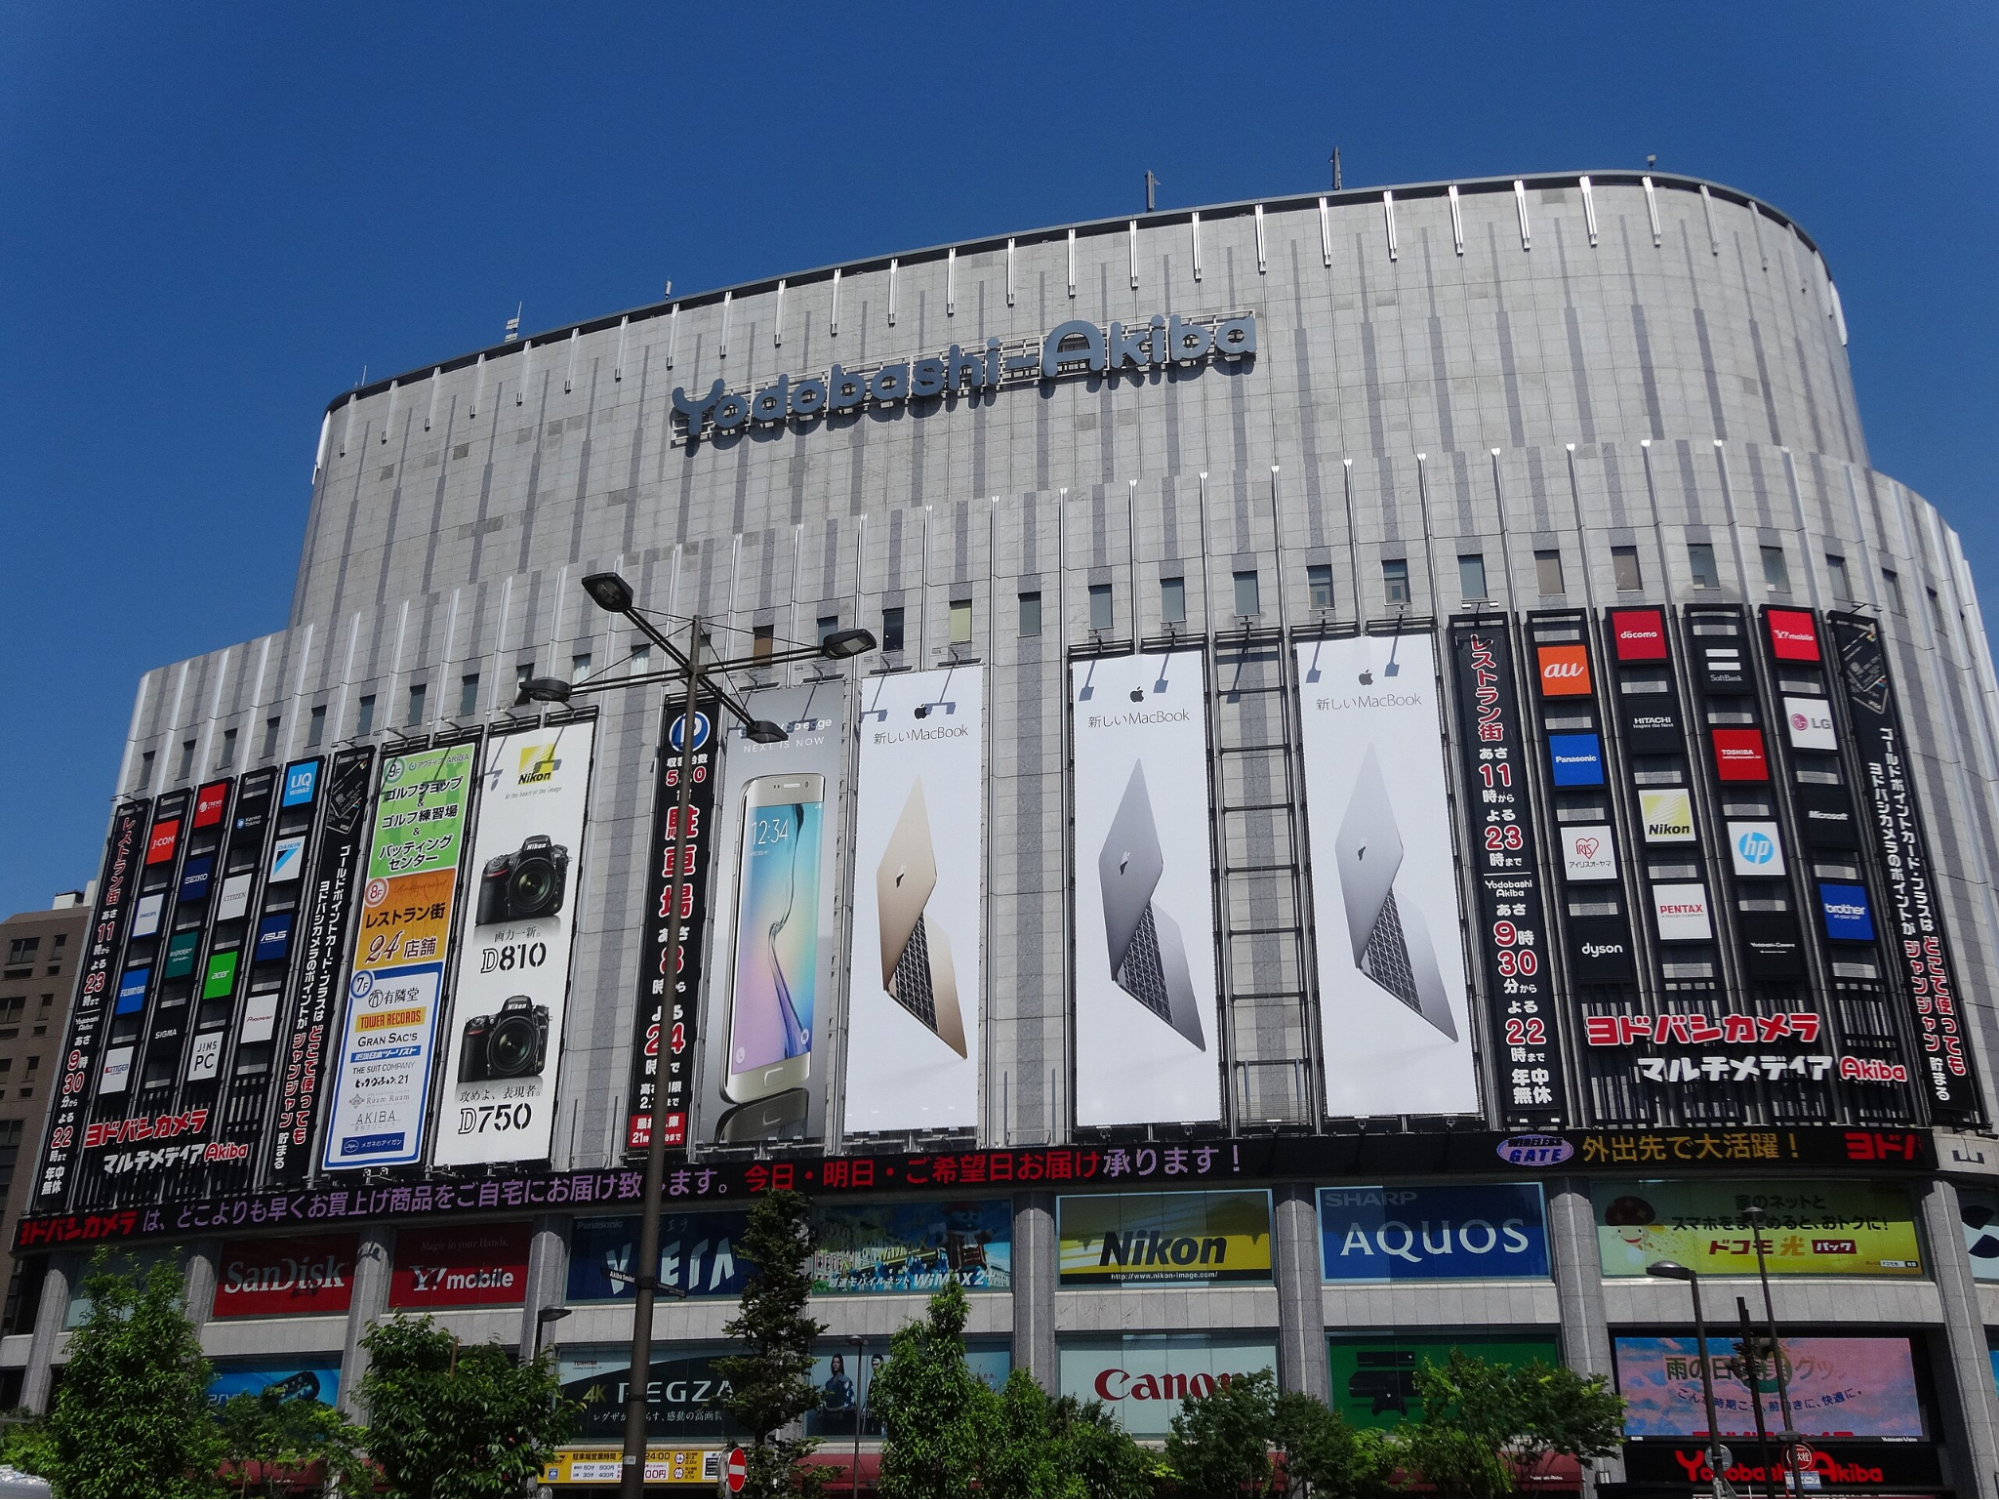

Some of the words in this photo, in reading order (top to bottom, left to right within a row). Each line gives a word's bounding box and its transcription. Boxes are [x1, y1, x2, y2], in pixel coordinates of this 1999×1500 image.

[672, 315, 1257, 436] Yodobashi-Akiba
[1620, 630, 1658, 639] docomo
[1774, 629, 1814, 641] Y!mobile
[1543, 662, 1585, 678] au
[1710, 674, 1743, 682] SoftBank
[1470, 634, 1504, 742] レストラン街
[1315, 693, 1423, 712] 新しいMacBook
[1088, 709, 1191, 729] 新しいMacBook
[1633, 716, 1671, 724] HITACHI
[1812, 717, 1831, 729] LG
[796, 736, 825, 748] NOW
[873, 724, 968, 745] 新しいMacBook
[1479, 747, 1508, 759] あさ
[1555, 754, 1597, 763] Panasonic
[388, 763, 401, 778] 9F
[518, 772, 552, 785] Nikon
[665, 765, 707, 787] 50
[1479, 762, 1512, 788] 11
[290, 771, 314, 789] UQ
[386, 776, 465, 801] ゴルフショップ
[381, 804, 459, 829] ゴルフ練習場
[1486, 808, 1516, 822] よる
[412, 827, 421, 836] &
[751, 818, 789, 846] 12:34
[1484, 825, 1524, 850] 23
[1648, 824, 1691, 836] Nikon
[379, 834, 454, 860] バッティング
[526, 843, 547, 851] Nikon
[1743, 832, 1770, 864] hp
[105, 816, 137, 907] レストラン街
[389, 854, 440, 871] センター
[1489, 852, 1523, 867] 時まで
[184, 872, 208, 886] SEIKO
[1485, 880, 1533, 890] Yodobashi
[370, 884, 383, 900] 8F
[1496, 889, 1525, 898] Akiba
[365, 902, 446, 929] レストラン街
[1496, 903, 1527, 916] あさ
[1659, 904, 1704, 914] PENTAX
[1824, 902, 1866, 915] brother
[97, 921, 116, 944] 11
[260, 930, 288, 943] ASUS
[1493, 920, 1535, 946] 9時
[480, 942, 547, 974] D810
[1581, 942, 1624, 958] dyson
[1497, 950, 1538, 977] 30
[84, 971, 107, 995] 23
[210, 970, 231, 980] acer
[356, 976, 369, 993] 7F
[1504, 978, 1538, 995] 分から
[507, 1002, 527, 1011] Nikon
[1507, 1000, 1538, 1013] よる
[360, 1014, 386, 1029] TOWER
[387, 1010, 422, 1027] RECORDS
[154, 1029, 178, 1040] SIGMA
[1505, 1017, 1547, 1045] 22
[1586, 1012, 1820, 1046] ヨドバシカメラ
[357, 1036, 387, 1048] GRAN
[193, 1053, 215, 1071] PC
[1511, 1047, 1546, 1063] 時まで
[352, 1066, 366, 1075] THE
[367, 1064, 381, 1073] SUIT
[382, 1061, 416, 1072] COMPANY
[1637, 1056, 1833, 1082] マルチメディア
[1838, 1055, 1908, 1083] Akiba
[62, 1071, 85, 1095] 30
[1511, 1068, 1550, 1086] 年中
[355, 1109, 397, 1126] AKIBA
[458, 1102, 532, 1135] D750
[84, 1108, 208, 1149] ヨドバシカメラ
[50, 1125, 74, 1150] 22
[1509, 1148, 1562, 1163] GATE
[1582, 1132, 1800, 1163] 外出先で大活躍！
[103, 1144, 206, 1175] マルチメディア
[203, 1142, 249, 1163] Akiba
[1325, 1191, 1418, 1207] SHARP
[576, 1219, 624, 1231] Panasonic
[1099, 1229, 1228, 1267] Nikon
[1340, 1218, 1530, 1263] AQUOS
[223, 1255, 346, 1294] SanDisk
[605, 1236, 736, 1296] VERA
[409, 1264, 514, 1292] Y!mobile
[583, 1384, 608, 1403] 4K
